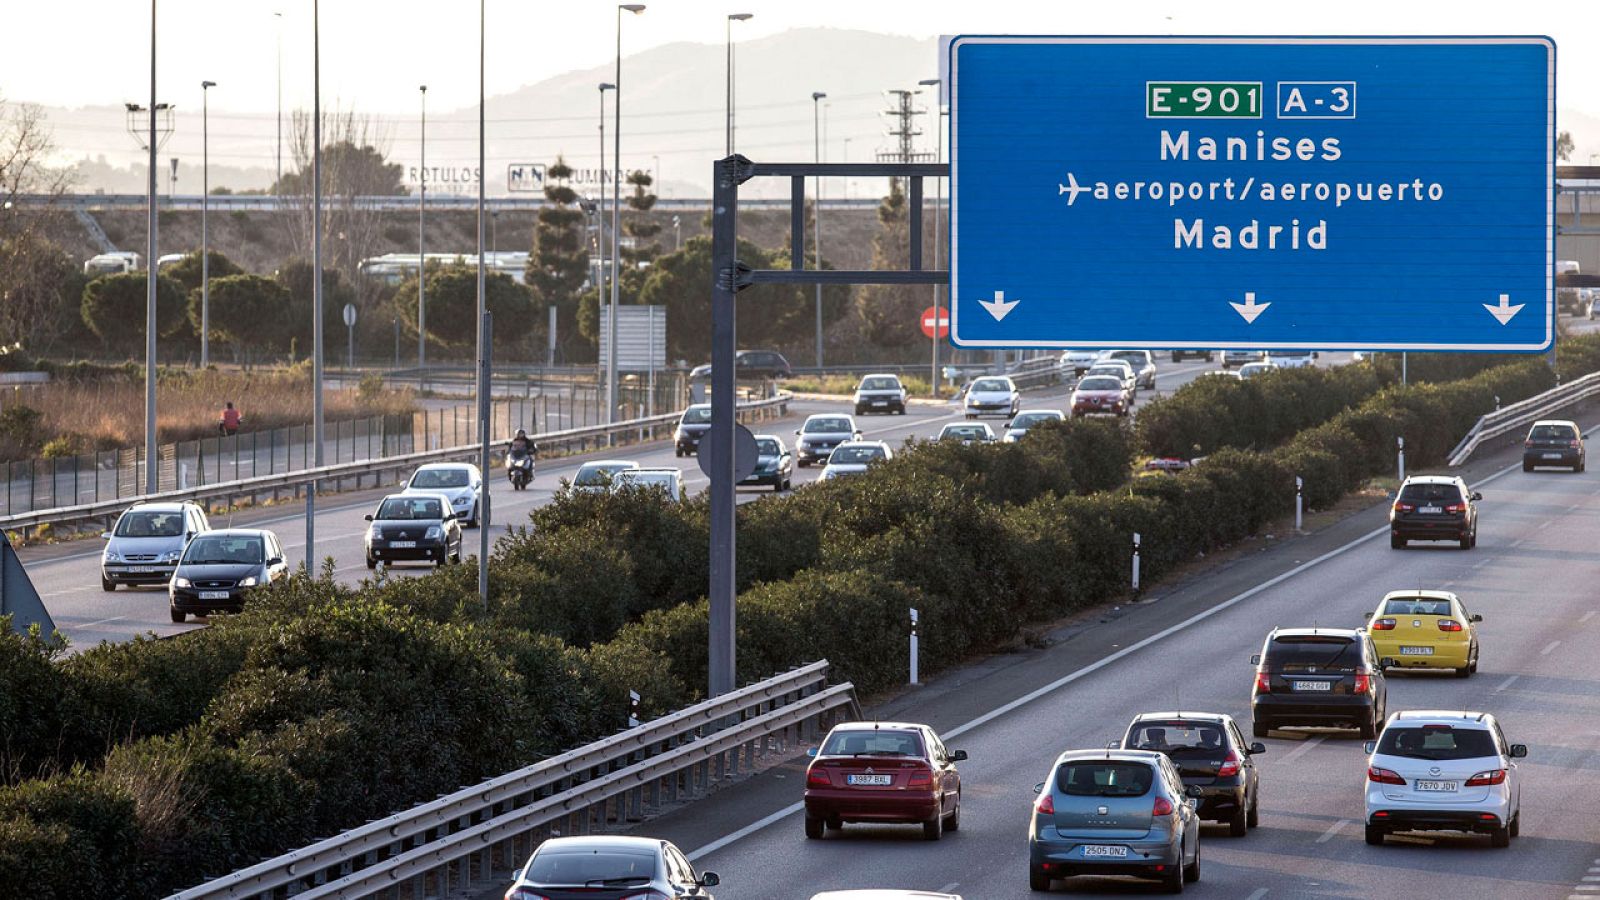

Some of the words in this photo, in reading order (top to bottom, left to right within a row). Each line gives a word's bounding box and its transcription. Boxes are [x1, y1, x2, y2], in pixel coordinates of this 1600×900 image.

[1153, 87, 1256, 113] E-901
[1284, 87, 1350, 113] A-3
[1160, 130, 1341, 161] Manises
[1094, 178, 1443, 207] aeroport/aeropuerto
[1174, 219, 1327, 250] Madrid
[854, 775, 872, 783] 3987
[1418, 781, 1440, 791] 7670
[1086, 846, 1107, 856] 2505
[1109, 847, 1126, 857] DNZ
